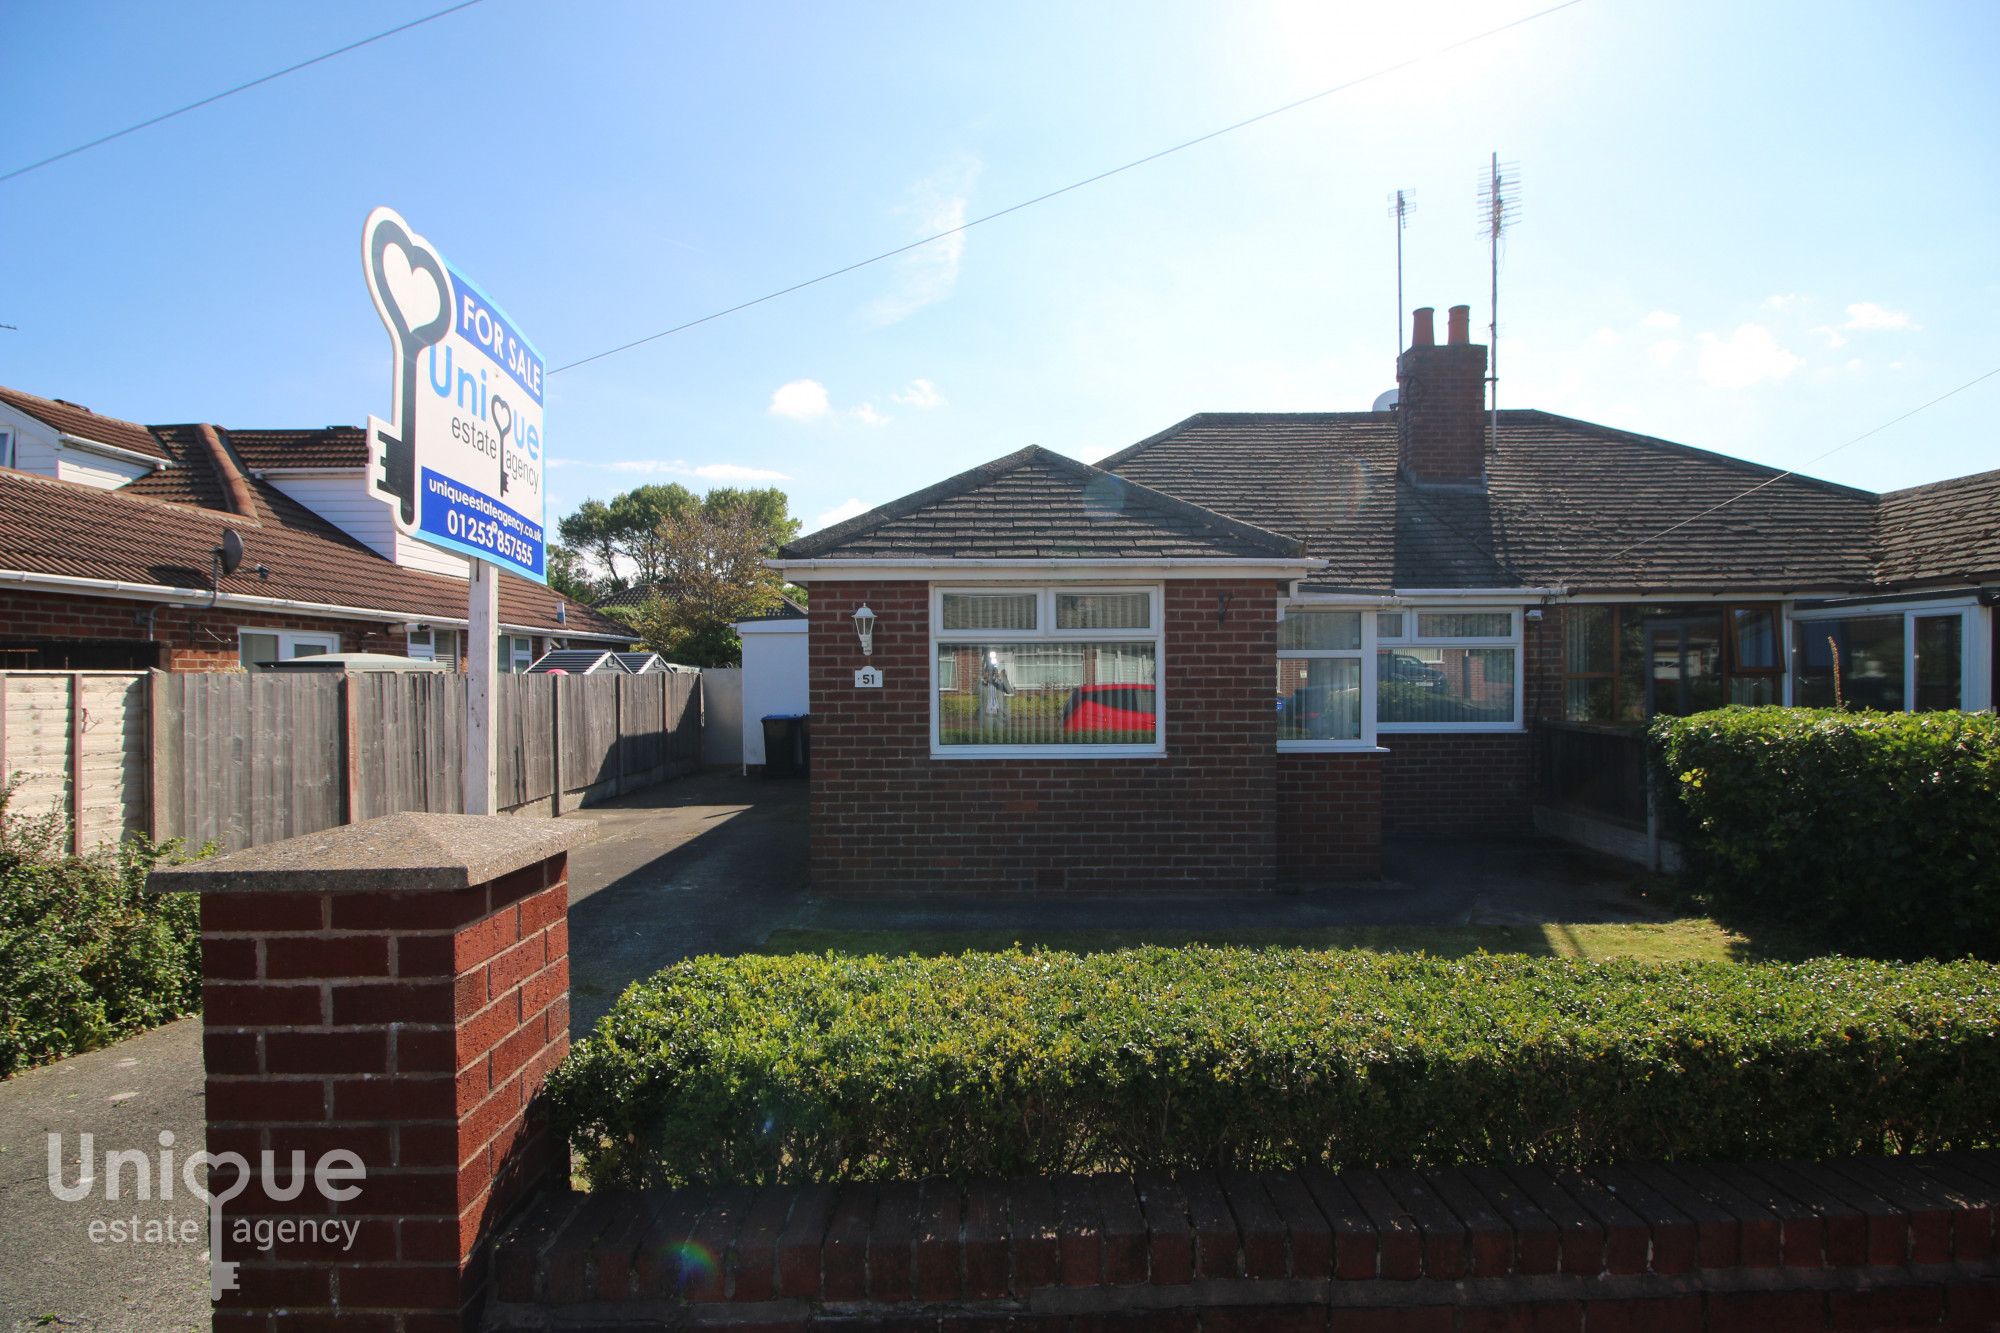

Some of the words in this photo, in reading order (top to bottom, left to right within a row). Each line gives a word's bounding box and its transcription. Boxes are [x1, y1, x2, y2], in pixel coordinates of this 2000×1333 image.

[463, 294, 504, 360] FOR
[508, 337, 541, 397] SALE
[429, 343, 539, 497] Unique
[452, 416, 497, 460] estate
[505, 449, 539, 494] agency
[429, 478, 542, 543] uniqueestateagency.co.uk
[447, 509, 494, 548] 01253
[497, 529, 533, 566] 857555
[862, 674, 875, 685] 51
